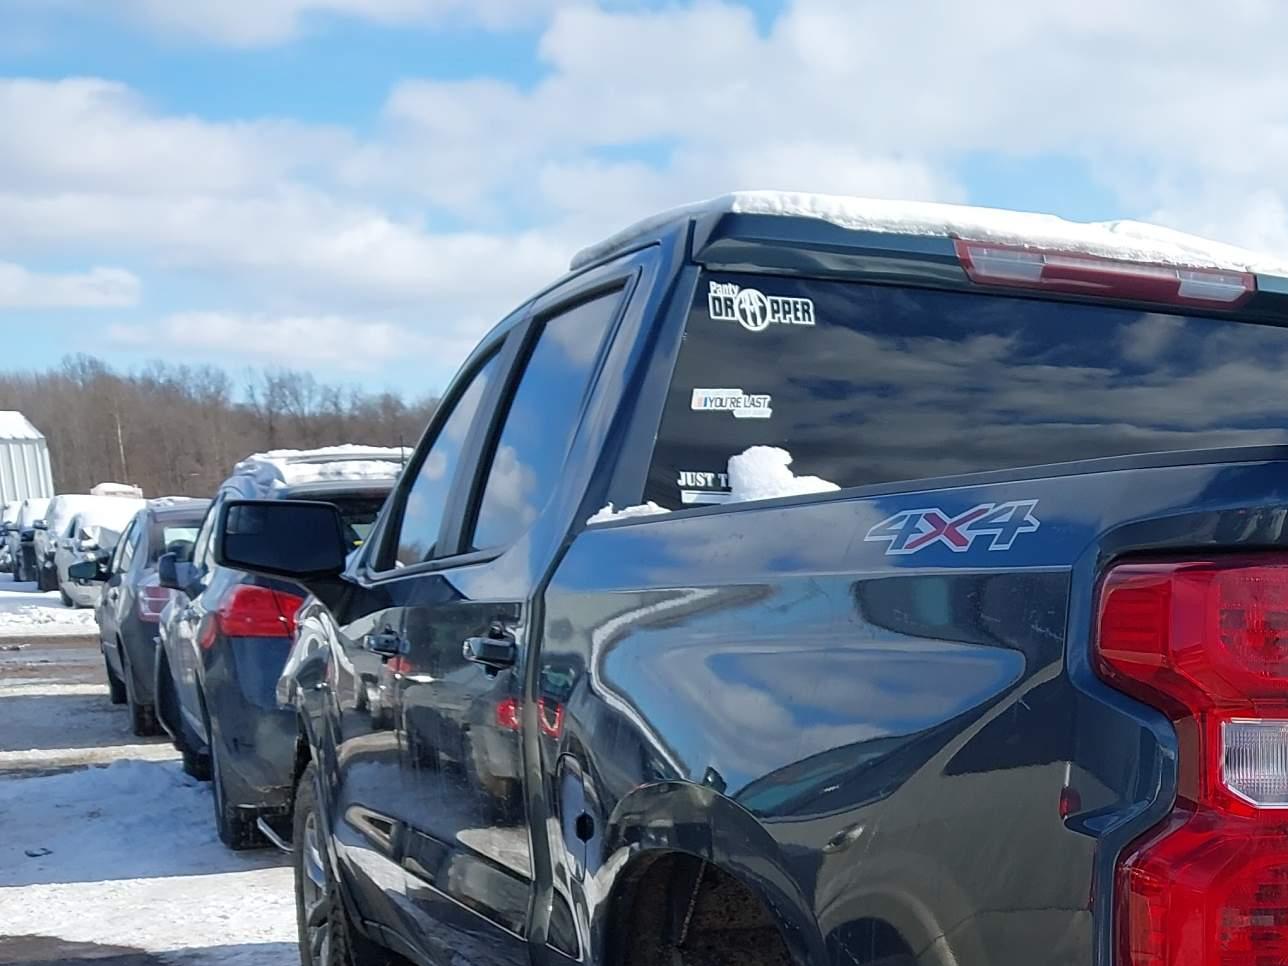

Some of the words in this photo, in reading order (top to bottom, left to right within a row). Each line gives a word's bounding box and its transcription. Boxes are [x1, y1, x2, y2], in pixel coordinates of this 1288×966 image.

[708, 396, 742, 409] YOU'RE
[743, 396, 769, 409] LAST
[677, 471, 715, 487] JUST
